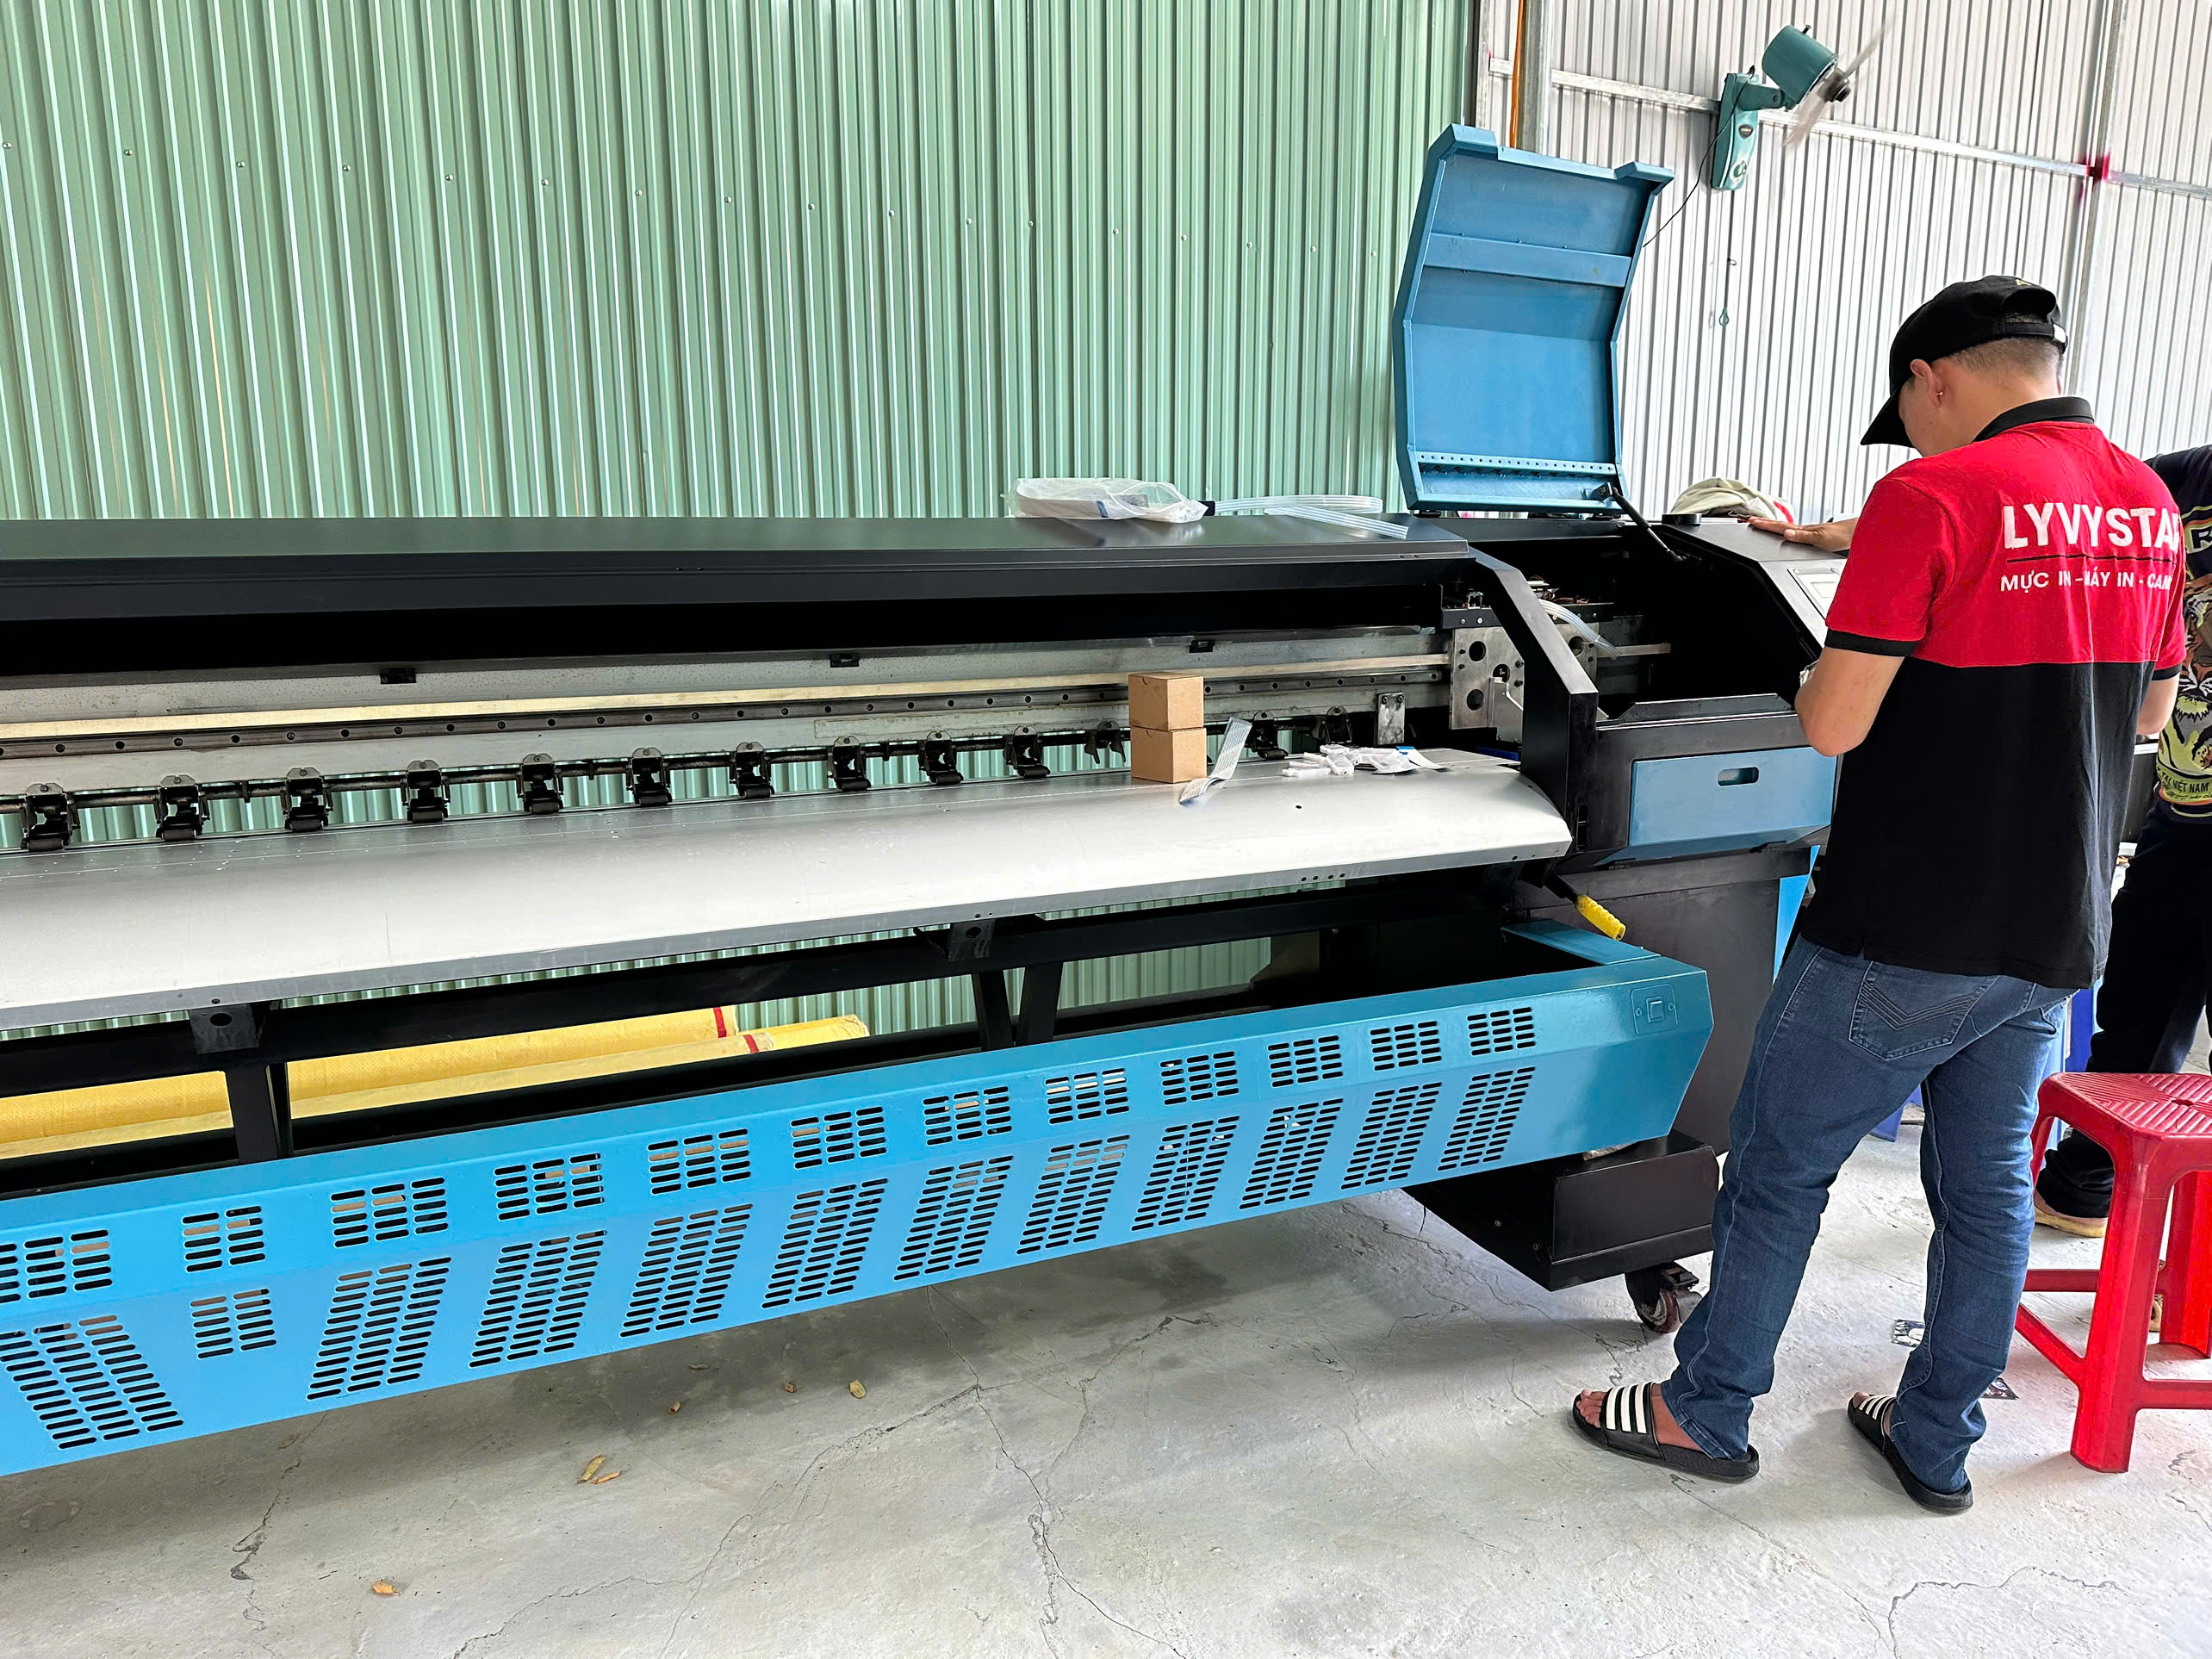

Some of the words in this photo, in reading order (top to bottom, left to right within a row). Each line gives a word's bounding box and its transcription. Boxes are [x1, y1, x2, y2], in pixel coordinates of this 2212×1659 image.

[2000, 569, 2050, 593] MỰC
[2058, 570, 2072, 587] IN
[2116, 571, 2134, 587] IN
[2190, 782, 2209, 792] NAM
